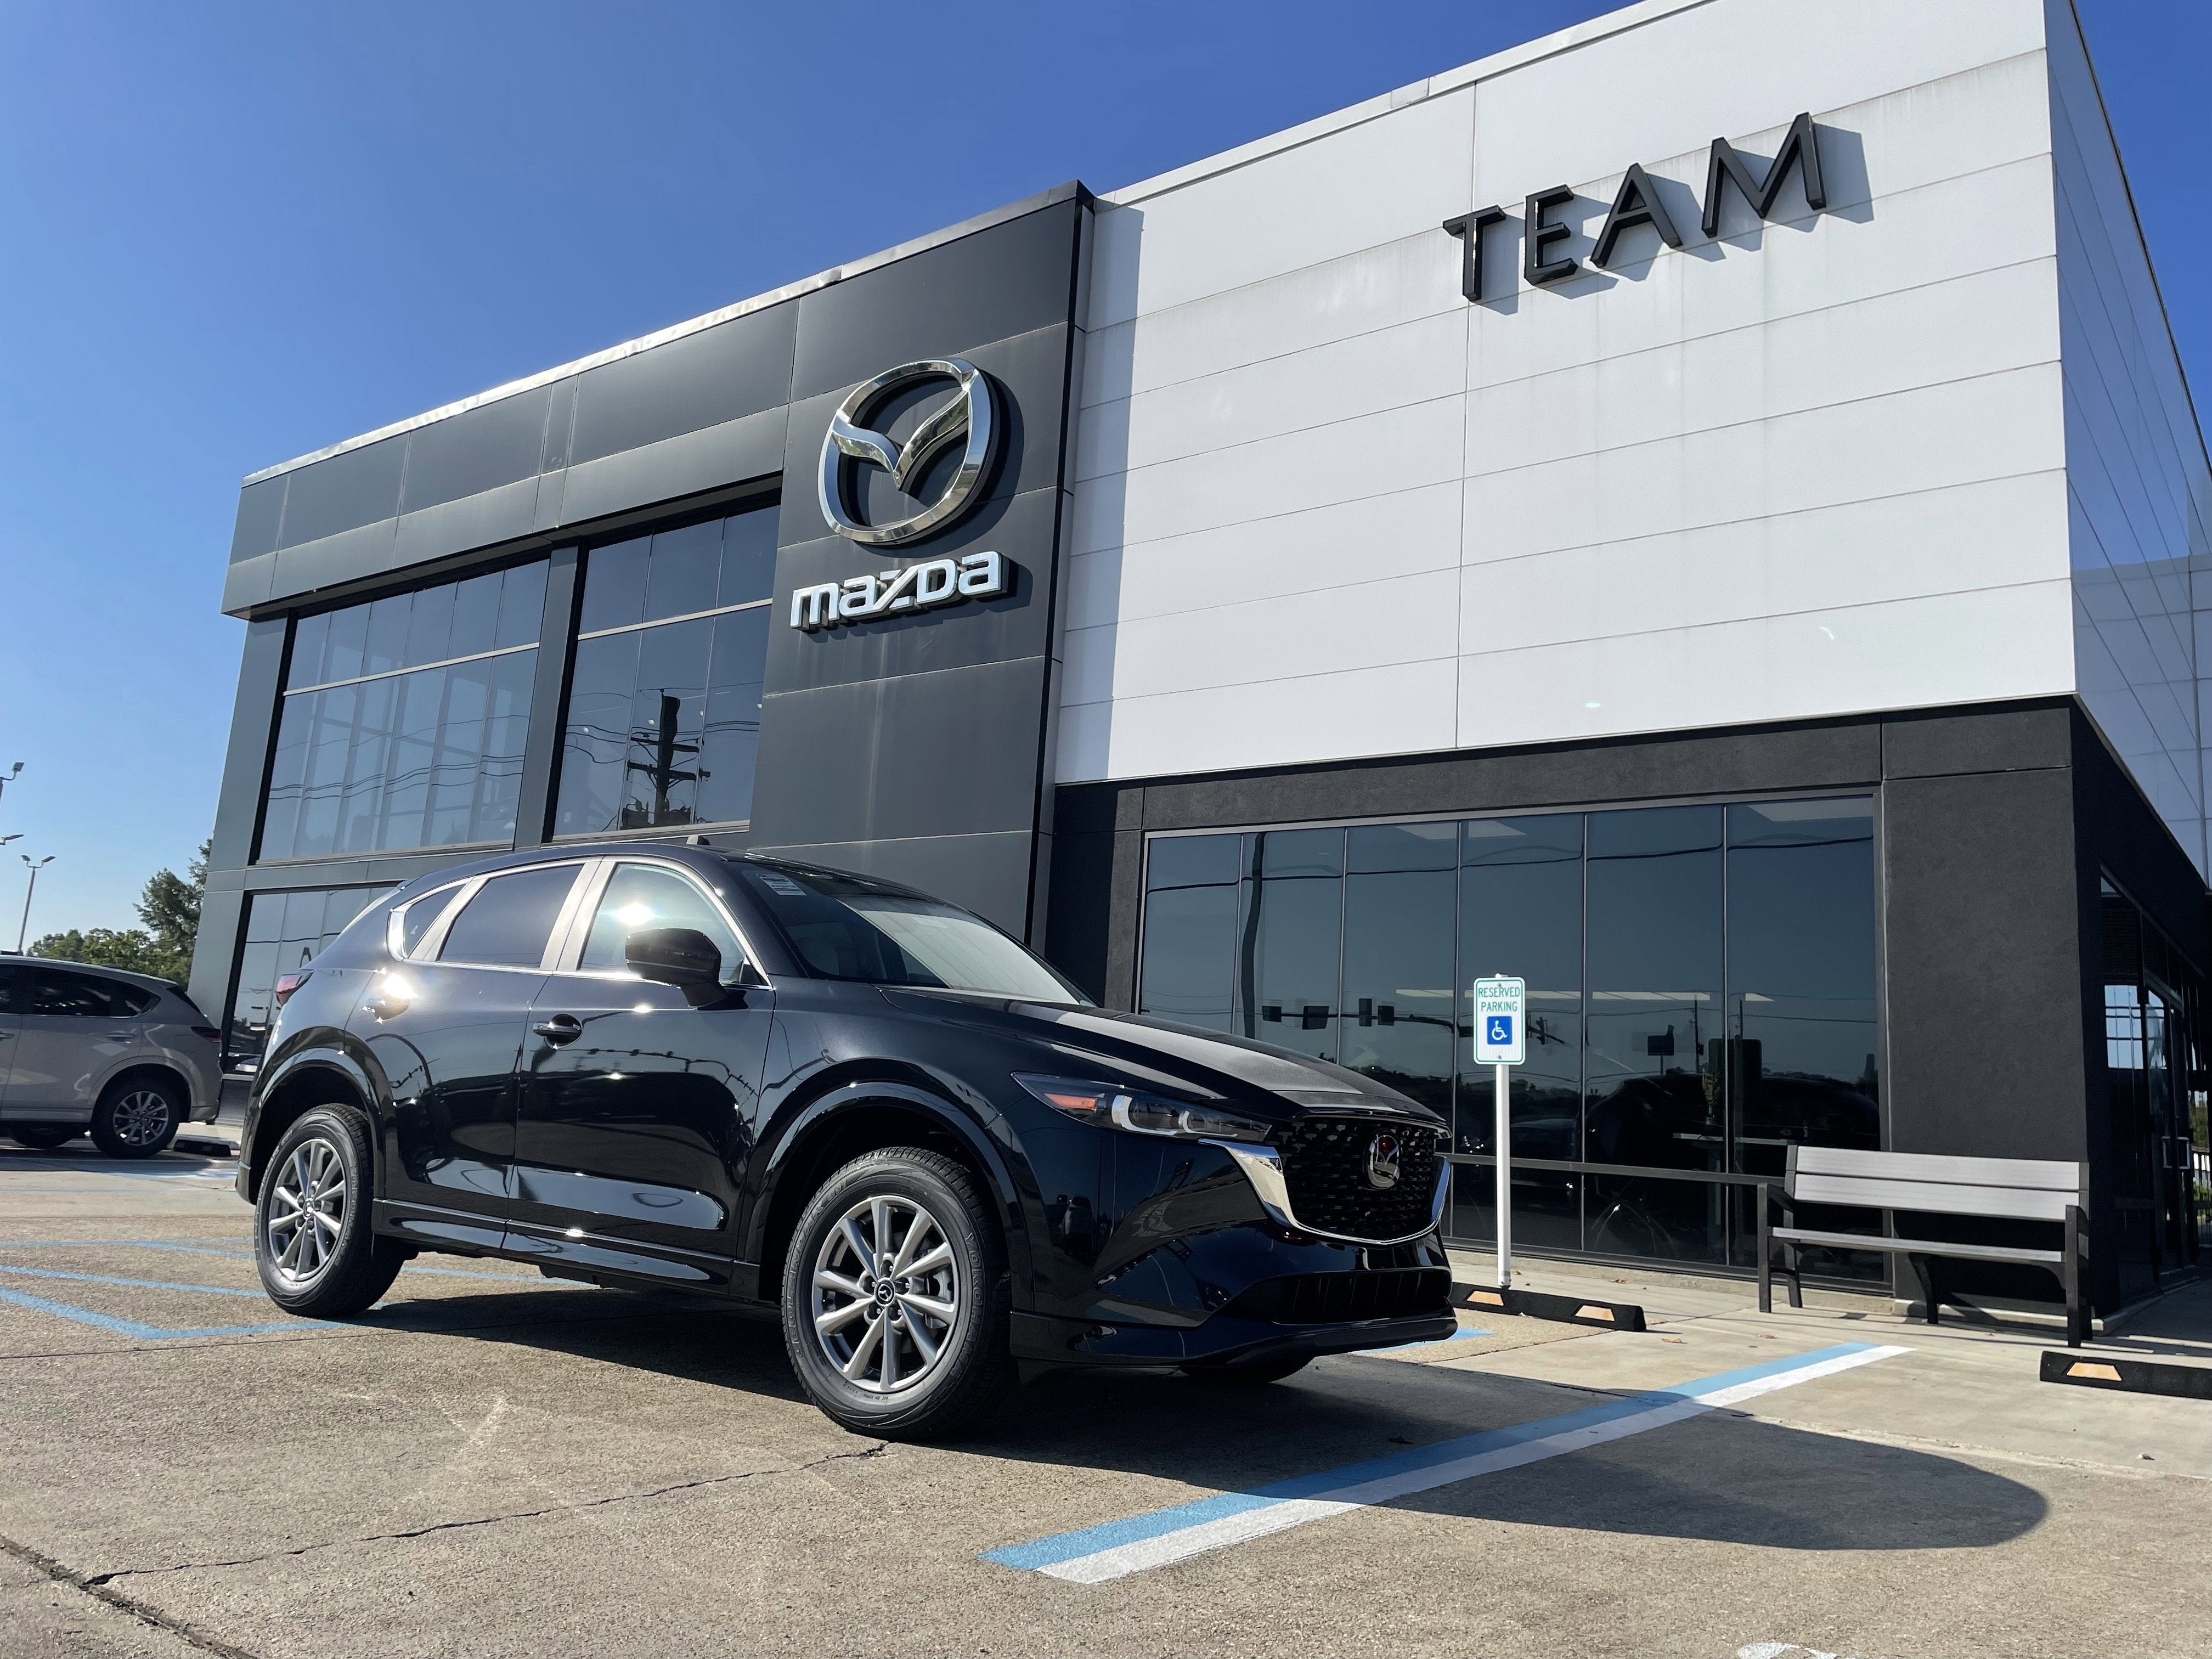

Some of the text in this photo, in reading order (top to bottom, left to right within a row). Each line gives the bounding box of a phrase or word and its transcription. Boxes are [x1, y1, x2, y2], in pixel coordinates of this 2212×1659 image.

[1442, 111, 1826, 302] TEAM
[1478, 987, 1521, 997] RESERVED
[1481, 1001, 1518, 1012] PARKING
[950, 1232, 984, 1379] YOKOHAMA
